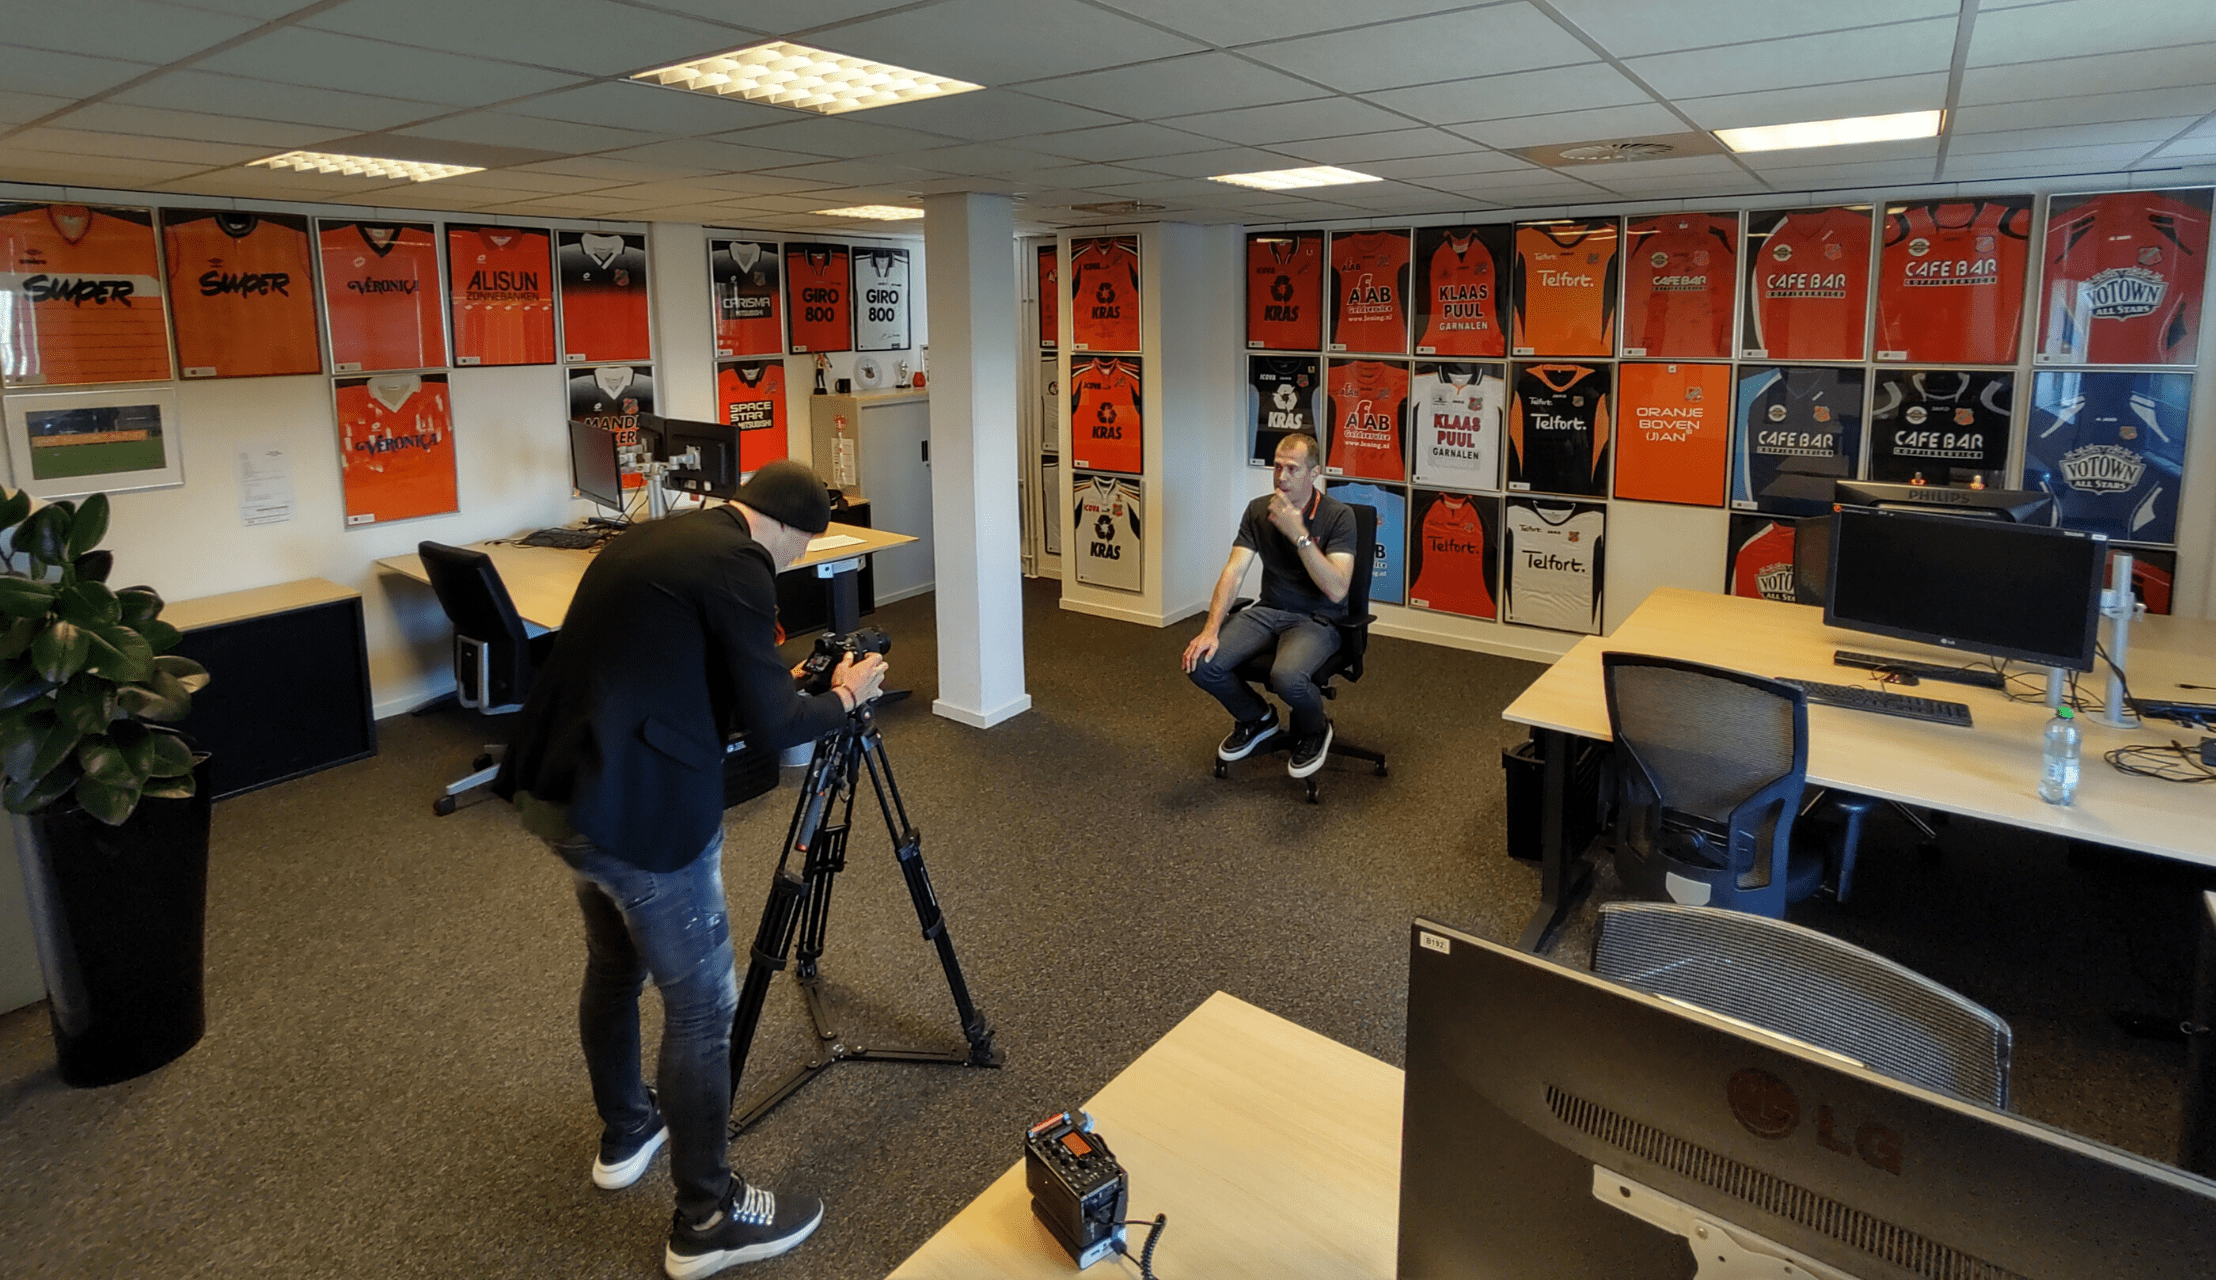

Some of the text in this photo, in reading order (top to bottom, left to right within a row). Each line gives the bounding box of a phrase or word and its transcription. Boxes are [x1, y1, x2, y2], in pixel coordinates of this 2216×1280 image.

[1906, 259, 1996, 276] CAFE BAR
[467, 270, 538, 291] ALISUN
[1653, 275, 1706, 285] CAFE BAR
[1767, 274, 1846, 288] CAFE BAR
[802, 287, 839, 304] GIRO
[866, 289, 899, 304] GIRO
[1439, 284, 1488, 301] KLAAS
[723, 297, 770, 309] CARISMA
[1443, 303, 1484, 318] PUUL
[805, 307, 834, 322] 800
[868, 307, 895, 322] 800
[1092, 306, 1120, 319] KRAS
[1264, 305, 1299, 321] KRAS
[2096, 307, 2115, 315] ALL
[1440, 322, 1488, 330] GARNALEN
[730, 401, 772, 413] SPACE
[1636, 407, 1704, 417] ORANJE
[730, 411, 764, 422] STAR
[1268, 411, 1303, 430] KRAS
[1434, 413, 1481, 432] KLAAS
[1639, 419, 1700, 430] BOVEN
[1092, 425, 1122, 440] KRAS
[1437, 430, 1475, 448] PUUL
[1758, 431, 1834, 448] CAFE BAR
[1895, 430, 1984, 449] CAFE BAR
[1432, 447, 1479, 460] GARNALEN
[2074, 480, 2126, 489] ALL STARS
[1908, 489, 1970, 504] PHILIPS
[1090, 541, 1121, 560] KRAS
[1761, 572, 1794, 592] VOTO
[1816, 1104, 1902, 1178] LG
